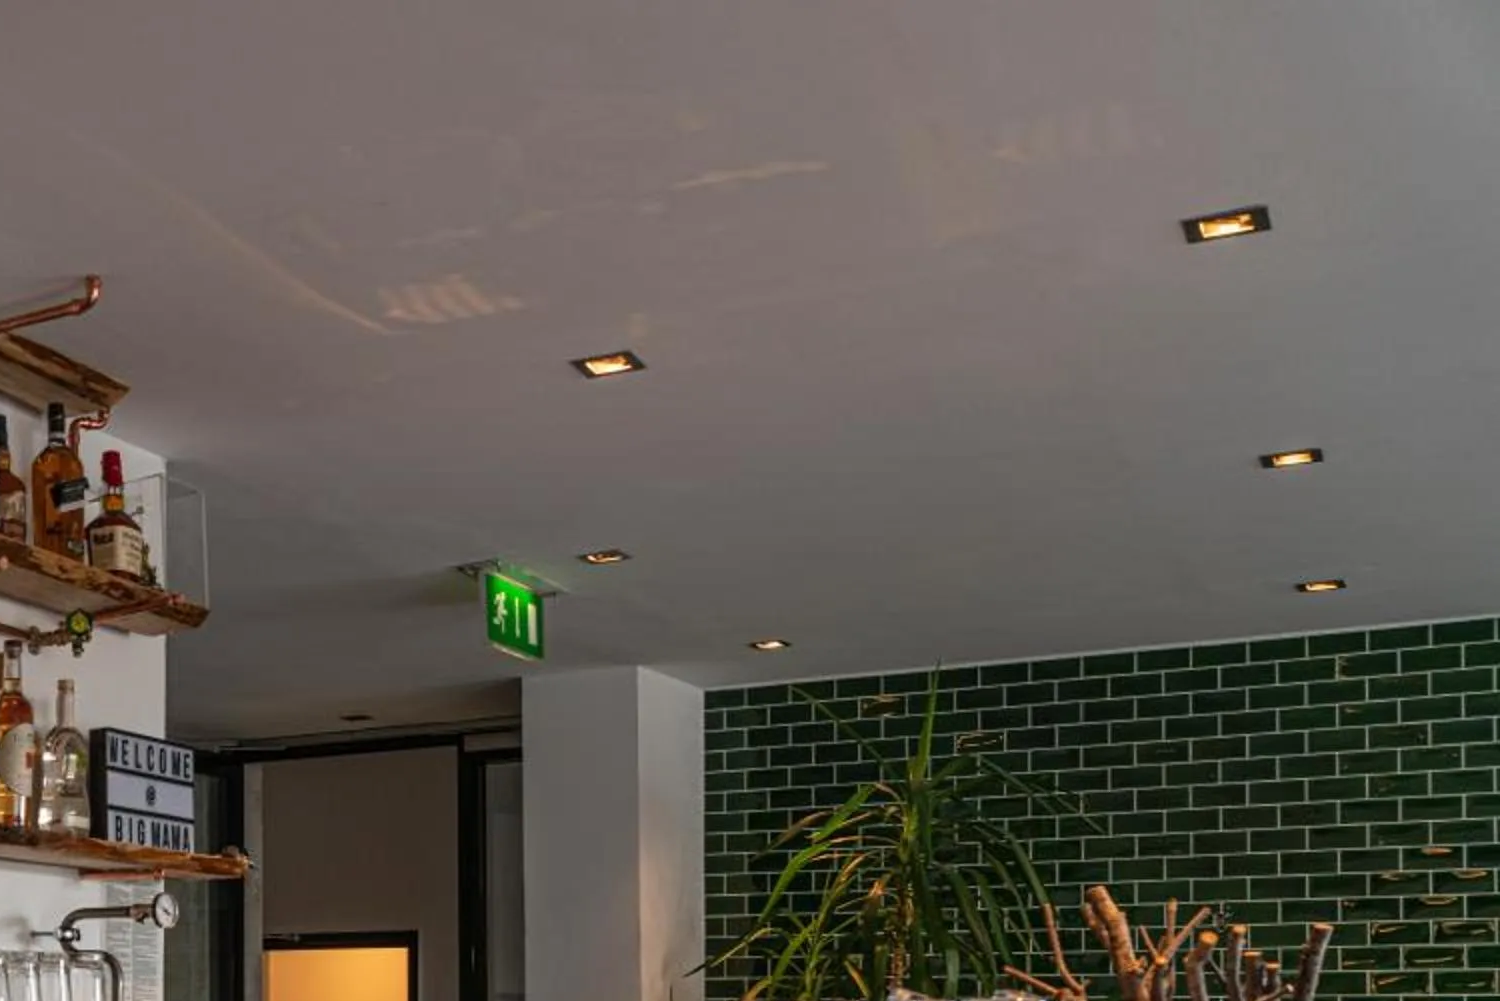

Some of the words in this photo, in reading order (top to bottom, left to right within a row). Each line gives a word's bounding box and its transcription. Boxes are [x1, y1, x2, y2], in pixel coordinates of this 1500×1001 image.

[109, 735, 192, 781] WELCOME
[145, 784, 157, 806] @
[115, 815, 145, 845] BIG
[150, 822, 192, 853] MAMA
